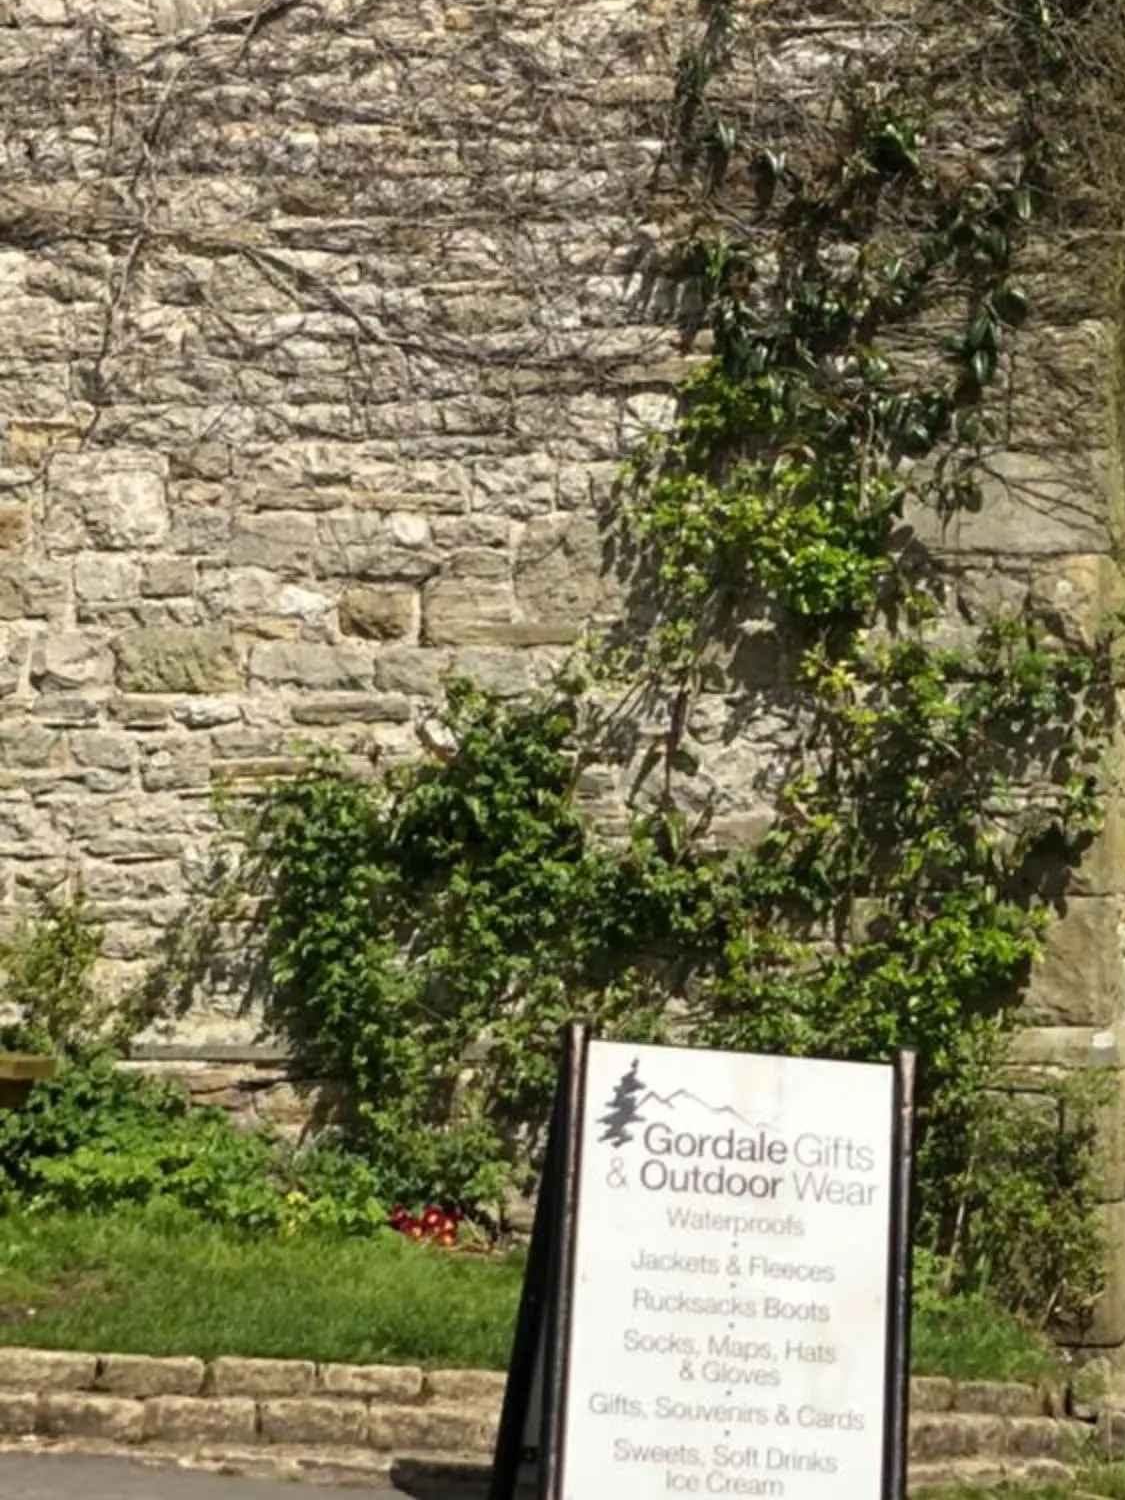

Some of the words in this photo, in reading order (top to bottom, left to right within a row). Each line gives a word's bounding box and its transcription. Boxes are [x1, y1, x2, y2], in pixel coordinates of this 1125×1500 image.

[643, 1121, 789, 1165] Gordale
[792, 1132, 876, 1173] Gifts
[605, 1156, 630, 1189] &
[639, 1159, 784, 1199] Outdoor
[791, 1171, 879, 1206] Wear
[666, 1205, 805, 1237] Waterproofs
[631, 1249, 720, 1274] Jackets
[726, 1254, 742, 1277] &
[749, 1256, 836, 1283] Fleeces
[632, 1288, 757, 1318] Rucksacks
[763, 1297, 831, 1323] Boots
[624, 1328, 700, 1356] Socks,
[707, 1334, 778, 1362] Maps,
[785, 1339, 838, 1364] Hats
[678, 1361, 695, 1382] &
[702, 1360, 781, 1387] Gloves
[588, 1391, 648, 1420] Gifts,
[655, 1396, 769, 1425] Souvenirs
[774, 1404, 790, 1426] &
[797, 1404, 865, 1431] Cards
[613, 1438, 706, 1467] Sweets,
[712, 1444, 759, 1468] Soft
[766, 1447, 838, 1473] Drinks
[665, 1470, 700, 1491] Ice
[705, 1471, 785, 1496] Cream
